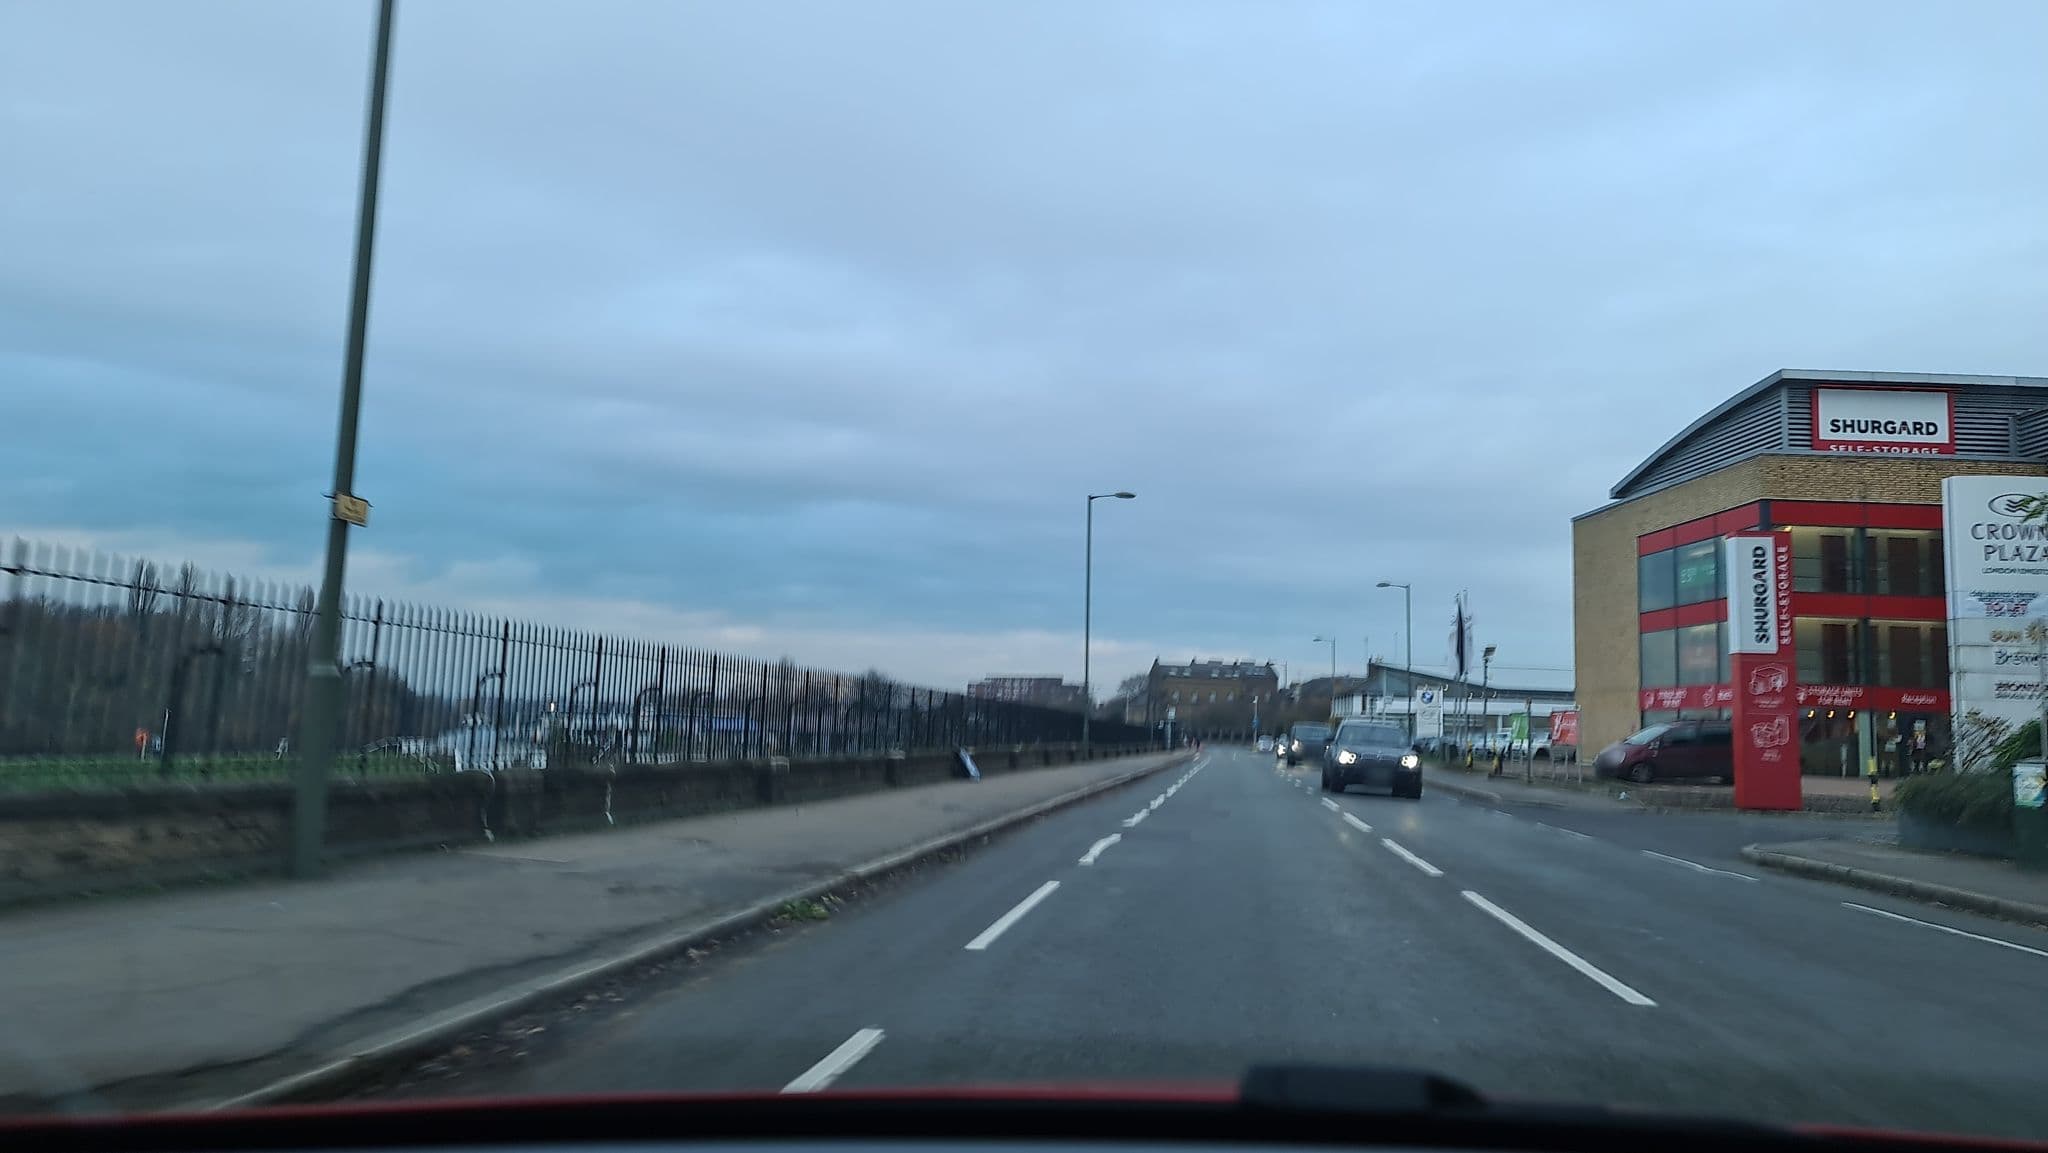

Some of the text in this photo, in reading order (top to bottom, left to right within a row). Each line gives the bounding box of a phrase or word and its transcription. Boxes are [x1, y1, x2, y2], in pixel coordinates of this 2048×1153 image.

[1829, 418, 1938, 436] SHURGARD
[1984, 544, 2048, 562] PLAZA
[1752, 545, 1770, 644] SHURGARD
[1776, 545, 1791, 645] SELF-STORAGE
